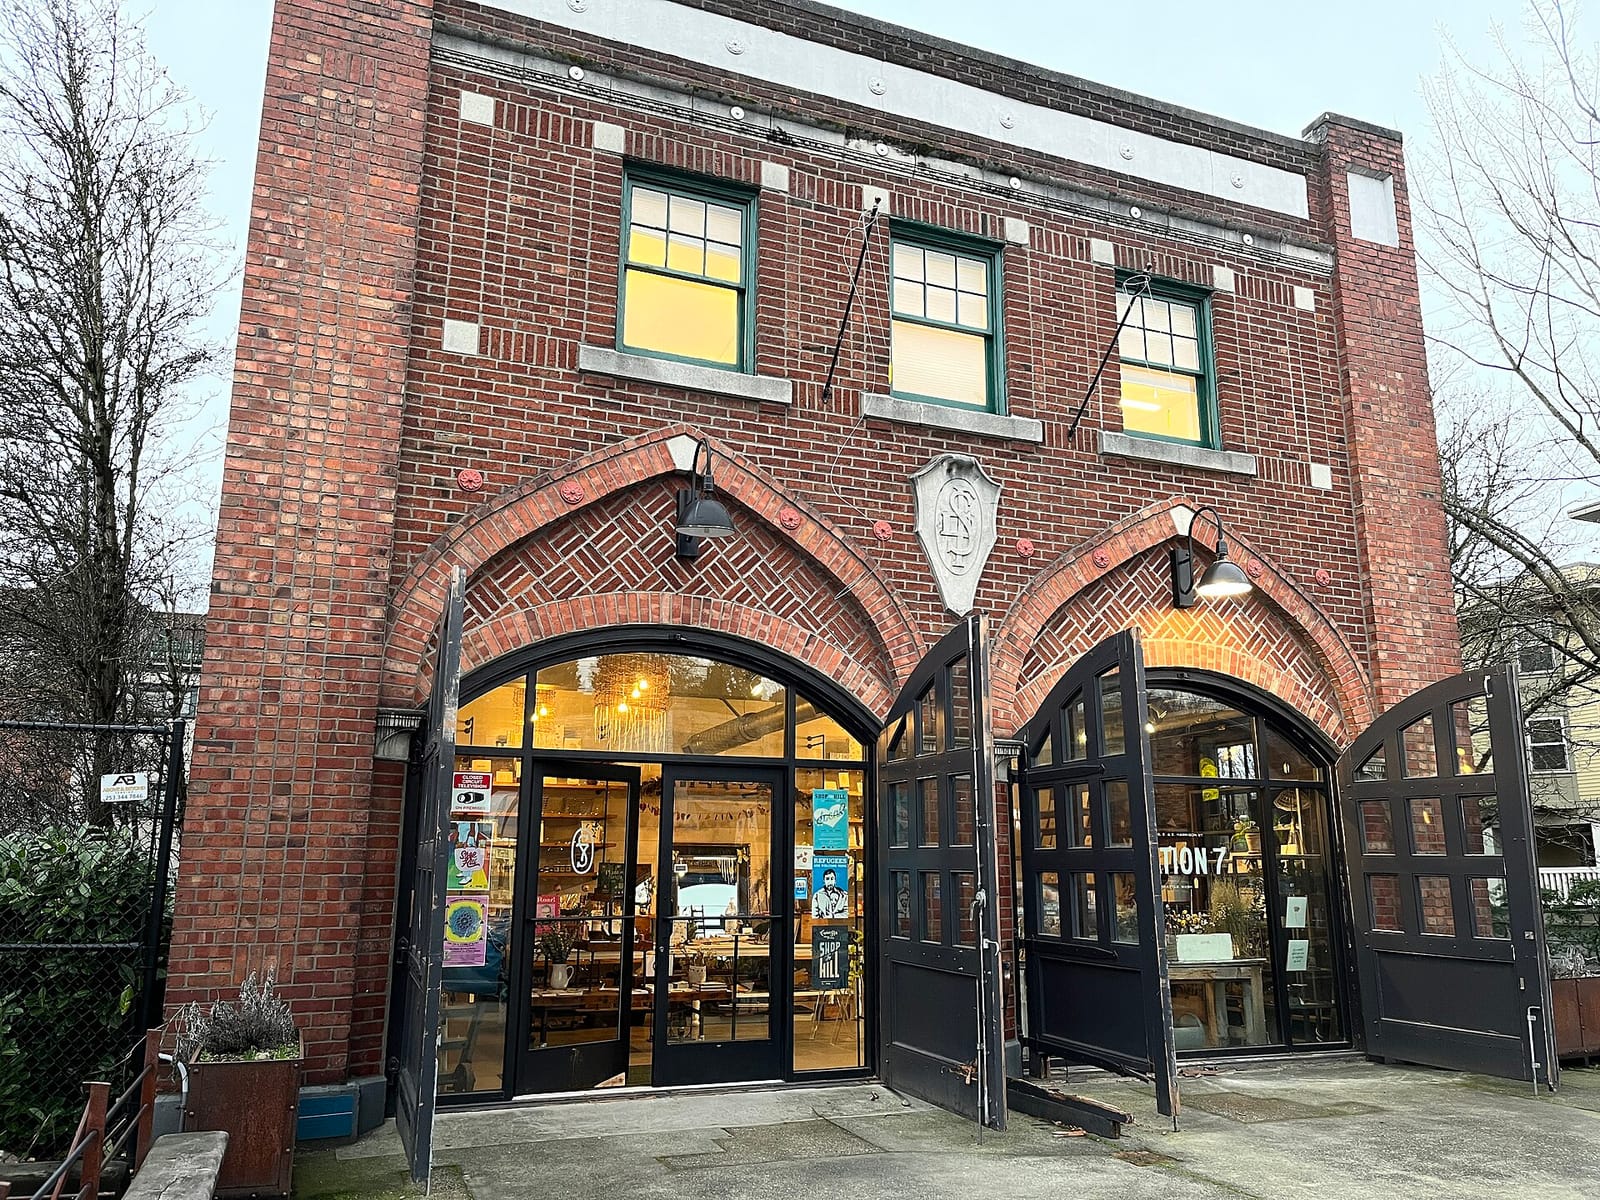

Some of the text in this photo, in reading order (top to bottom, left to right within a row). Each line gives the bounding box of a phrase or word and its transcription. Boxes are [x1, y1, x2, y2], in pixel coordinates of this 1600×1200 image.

[112, 775, 136, 787] AB
[1212, 846, 1227, 875] 7
[819, 941, 841, 957] SHOP
[819, 950, 841, 978] HILL
